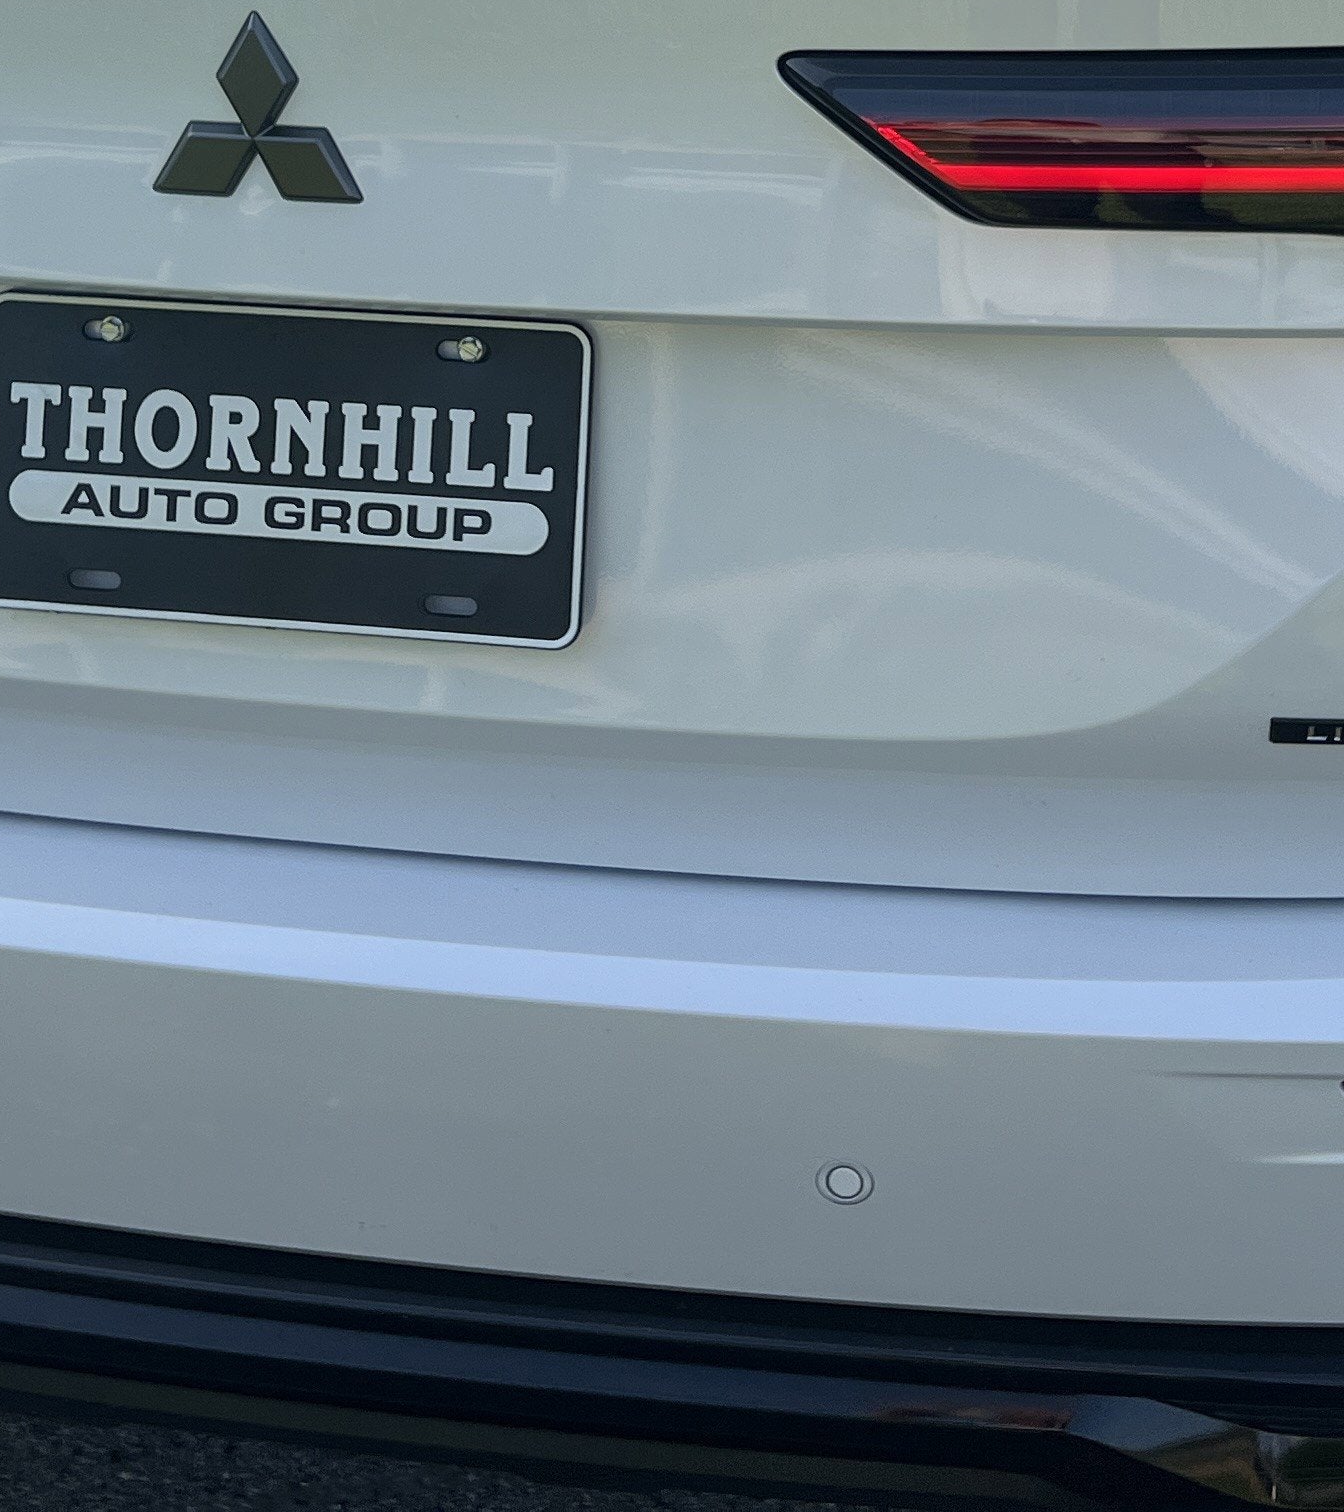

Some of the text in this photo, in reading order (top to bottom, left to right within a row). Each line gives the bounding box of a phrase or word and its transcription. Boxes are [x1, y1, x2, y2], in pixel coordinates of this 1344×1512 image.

[10, 381, 553, 491] THORNHILL
[61, 483, 492, 541] AUTO GROUP
